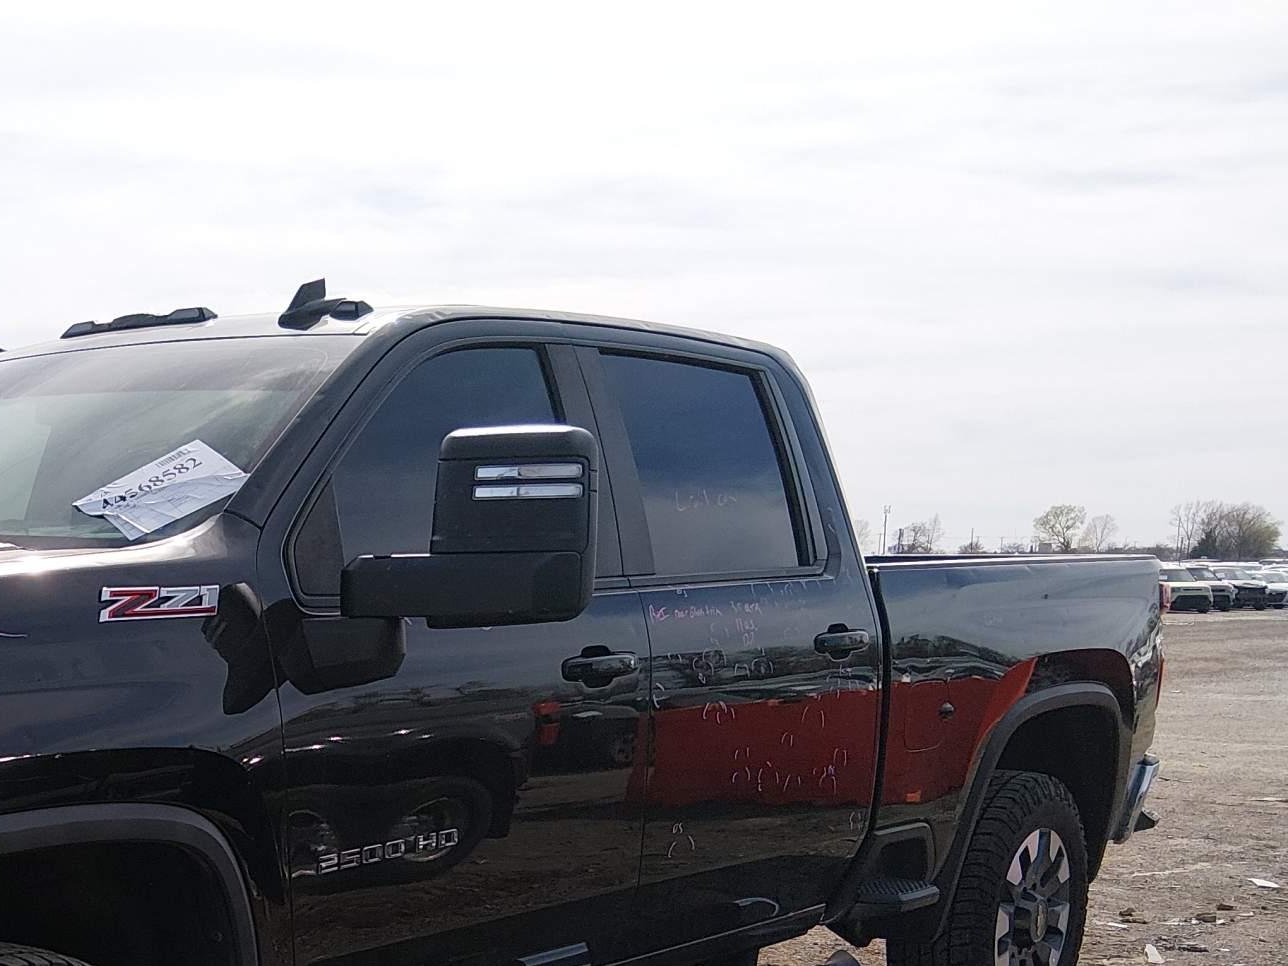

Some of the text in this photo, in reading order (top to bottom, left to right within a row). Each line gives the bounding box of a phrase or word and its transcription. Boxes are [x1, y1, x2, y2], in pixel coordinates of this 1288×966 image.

[101, 457, 203, 510] 44568582
[98, 584, 220, 622] Z71
[318, 828, 459, 875] 2500 HD
